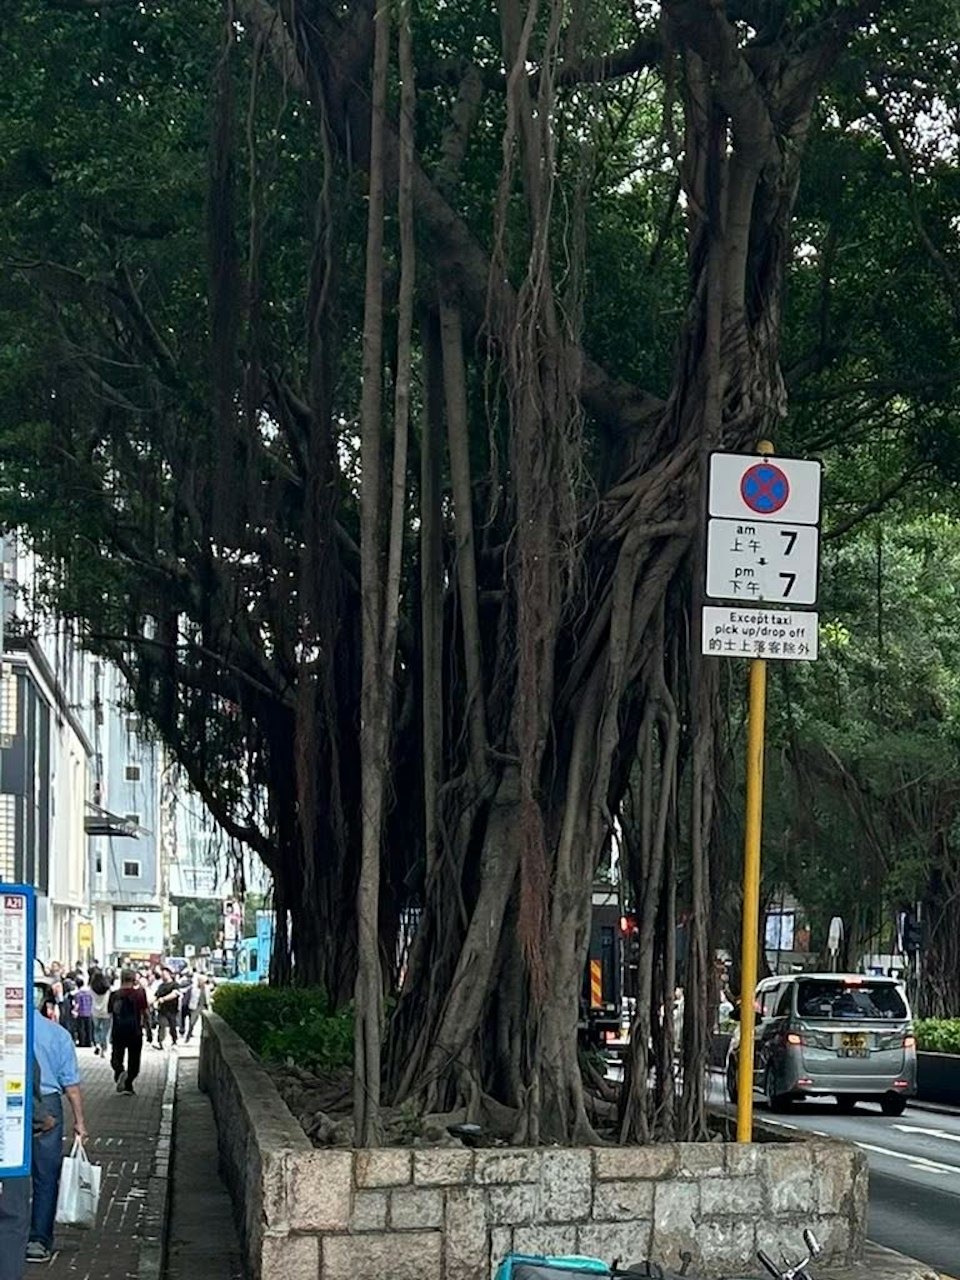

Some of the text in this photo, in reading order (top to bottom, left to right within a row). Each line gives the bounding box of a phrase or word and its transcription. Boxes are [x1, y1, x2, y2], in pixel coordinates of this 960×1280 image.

[736, 525, 756, 535] am
[729, 538, 761, 554] 上午
[780, 530, 798, 556] 7
[734, 567, 755, 578] pm
[729, 580, 761, 595] 下午
[779, 572, 796, 597] 7
[729, 612, 792, 625] Except taxi
[715, 624, 805, 638] pick up/drop off
[709, 638, 810, 655] 的士上落客除外
